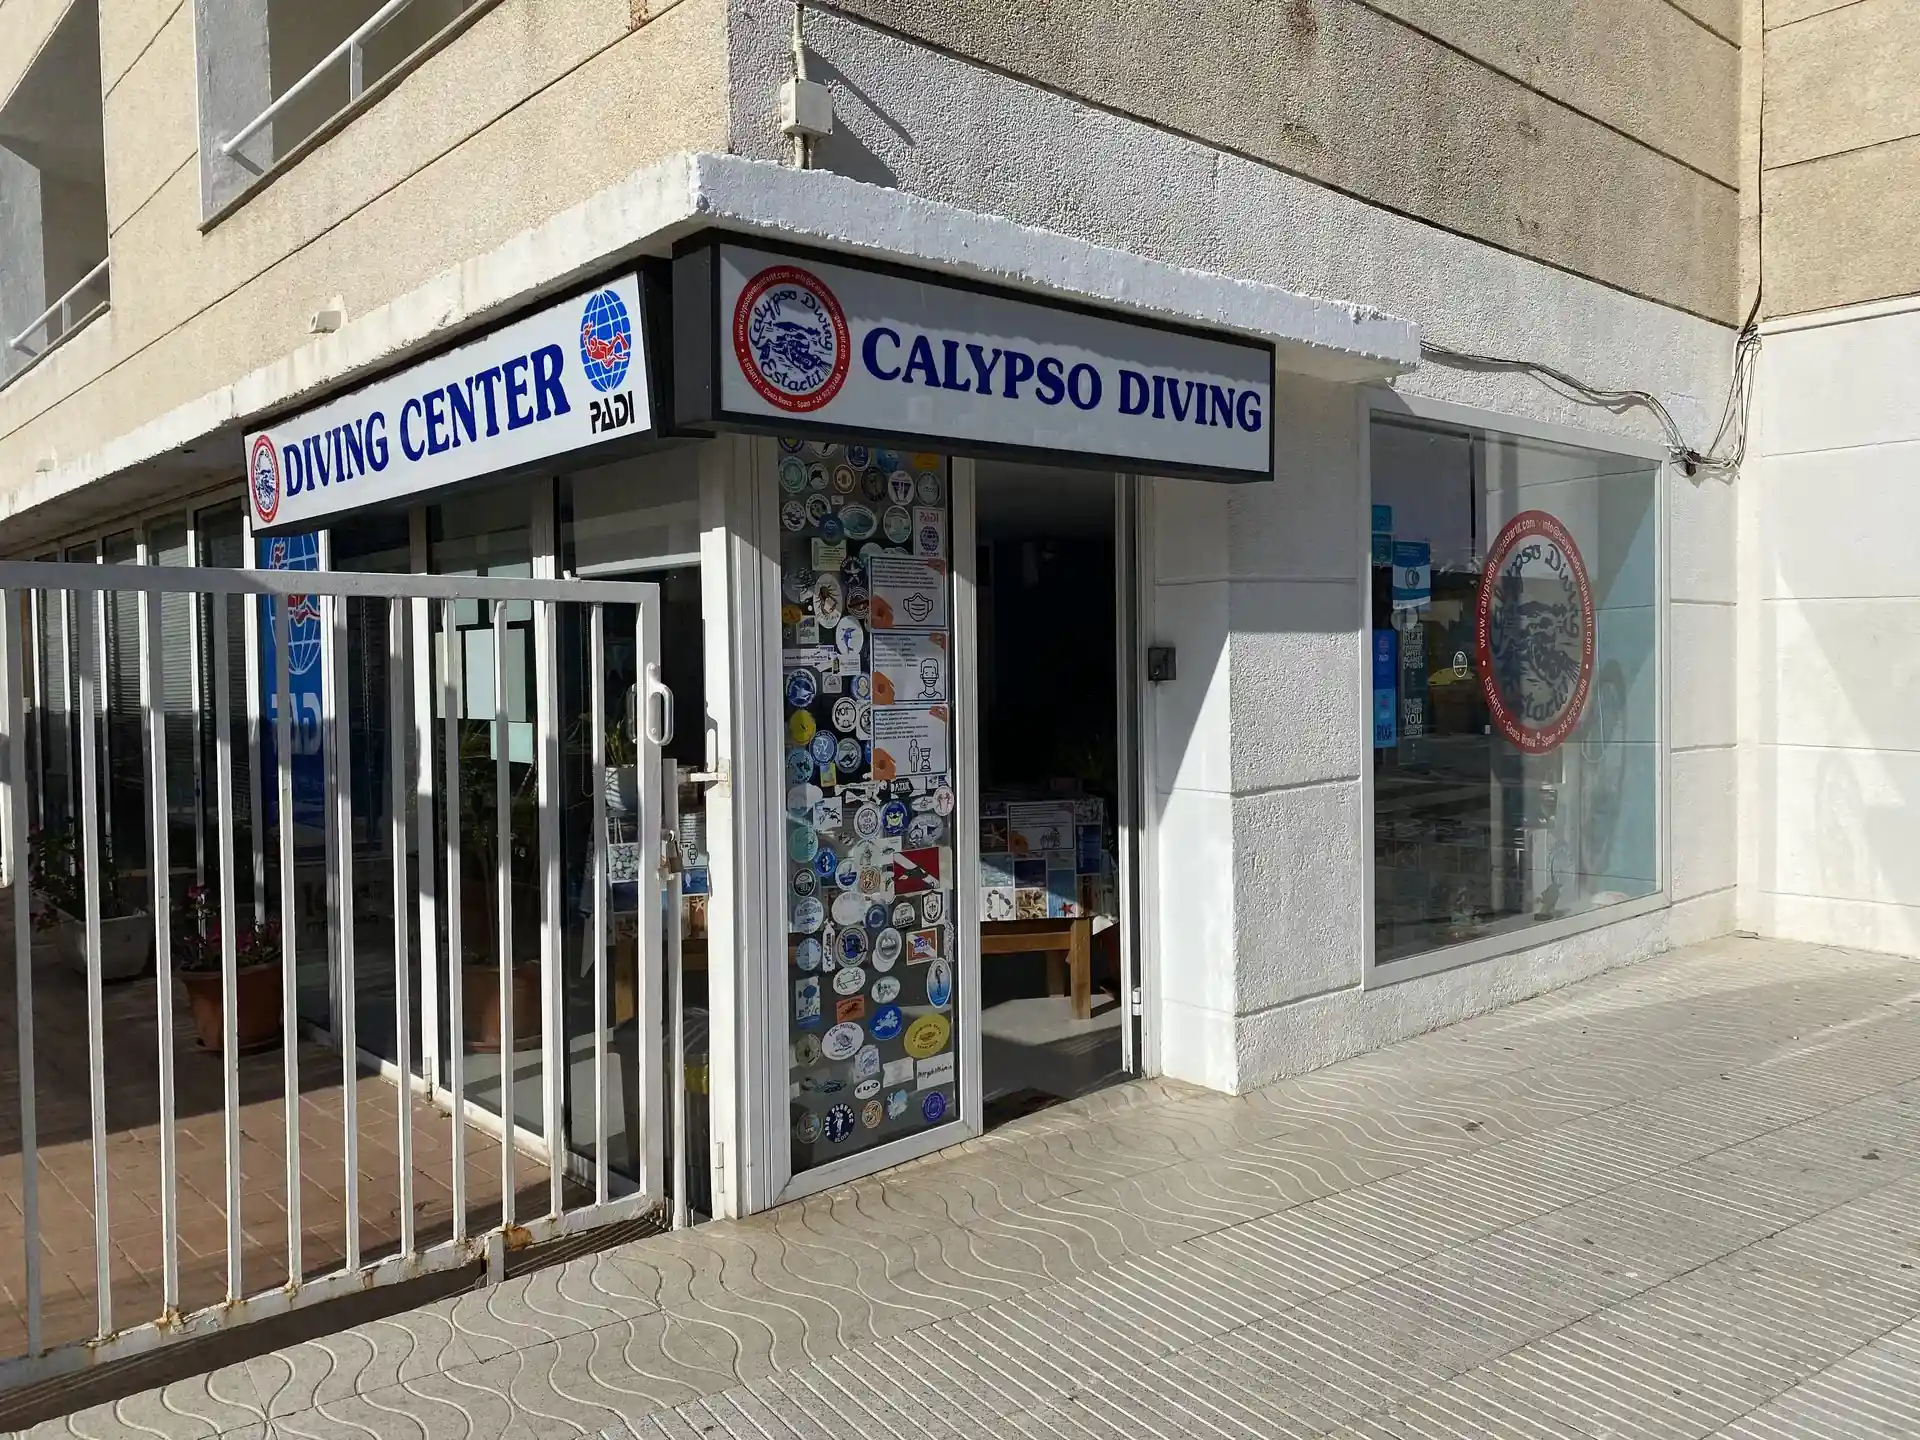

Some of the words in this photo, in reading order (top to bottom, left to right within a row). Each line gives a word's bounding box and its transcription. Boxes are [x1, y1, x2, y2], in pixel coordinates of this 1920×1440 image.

[749, 289, 798, 350] Calypso
[800, 291, 834, 351] Diving
[760, 357, 825, 393] Estartit
[861, 326, 1103, 412] CALYPSO
[1117, 368, 1263, 434] DIVING
[282, 411, 390, 498] DIVING
[399, 343, 572, 463] CENTER
[589, 390, 635, 434] PADI
[1404, 713, 1422, 725] YOU
[1484, 676, 1505, 719] ESTARTIT
[1505, 720, 1521, 742] Costa
